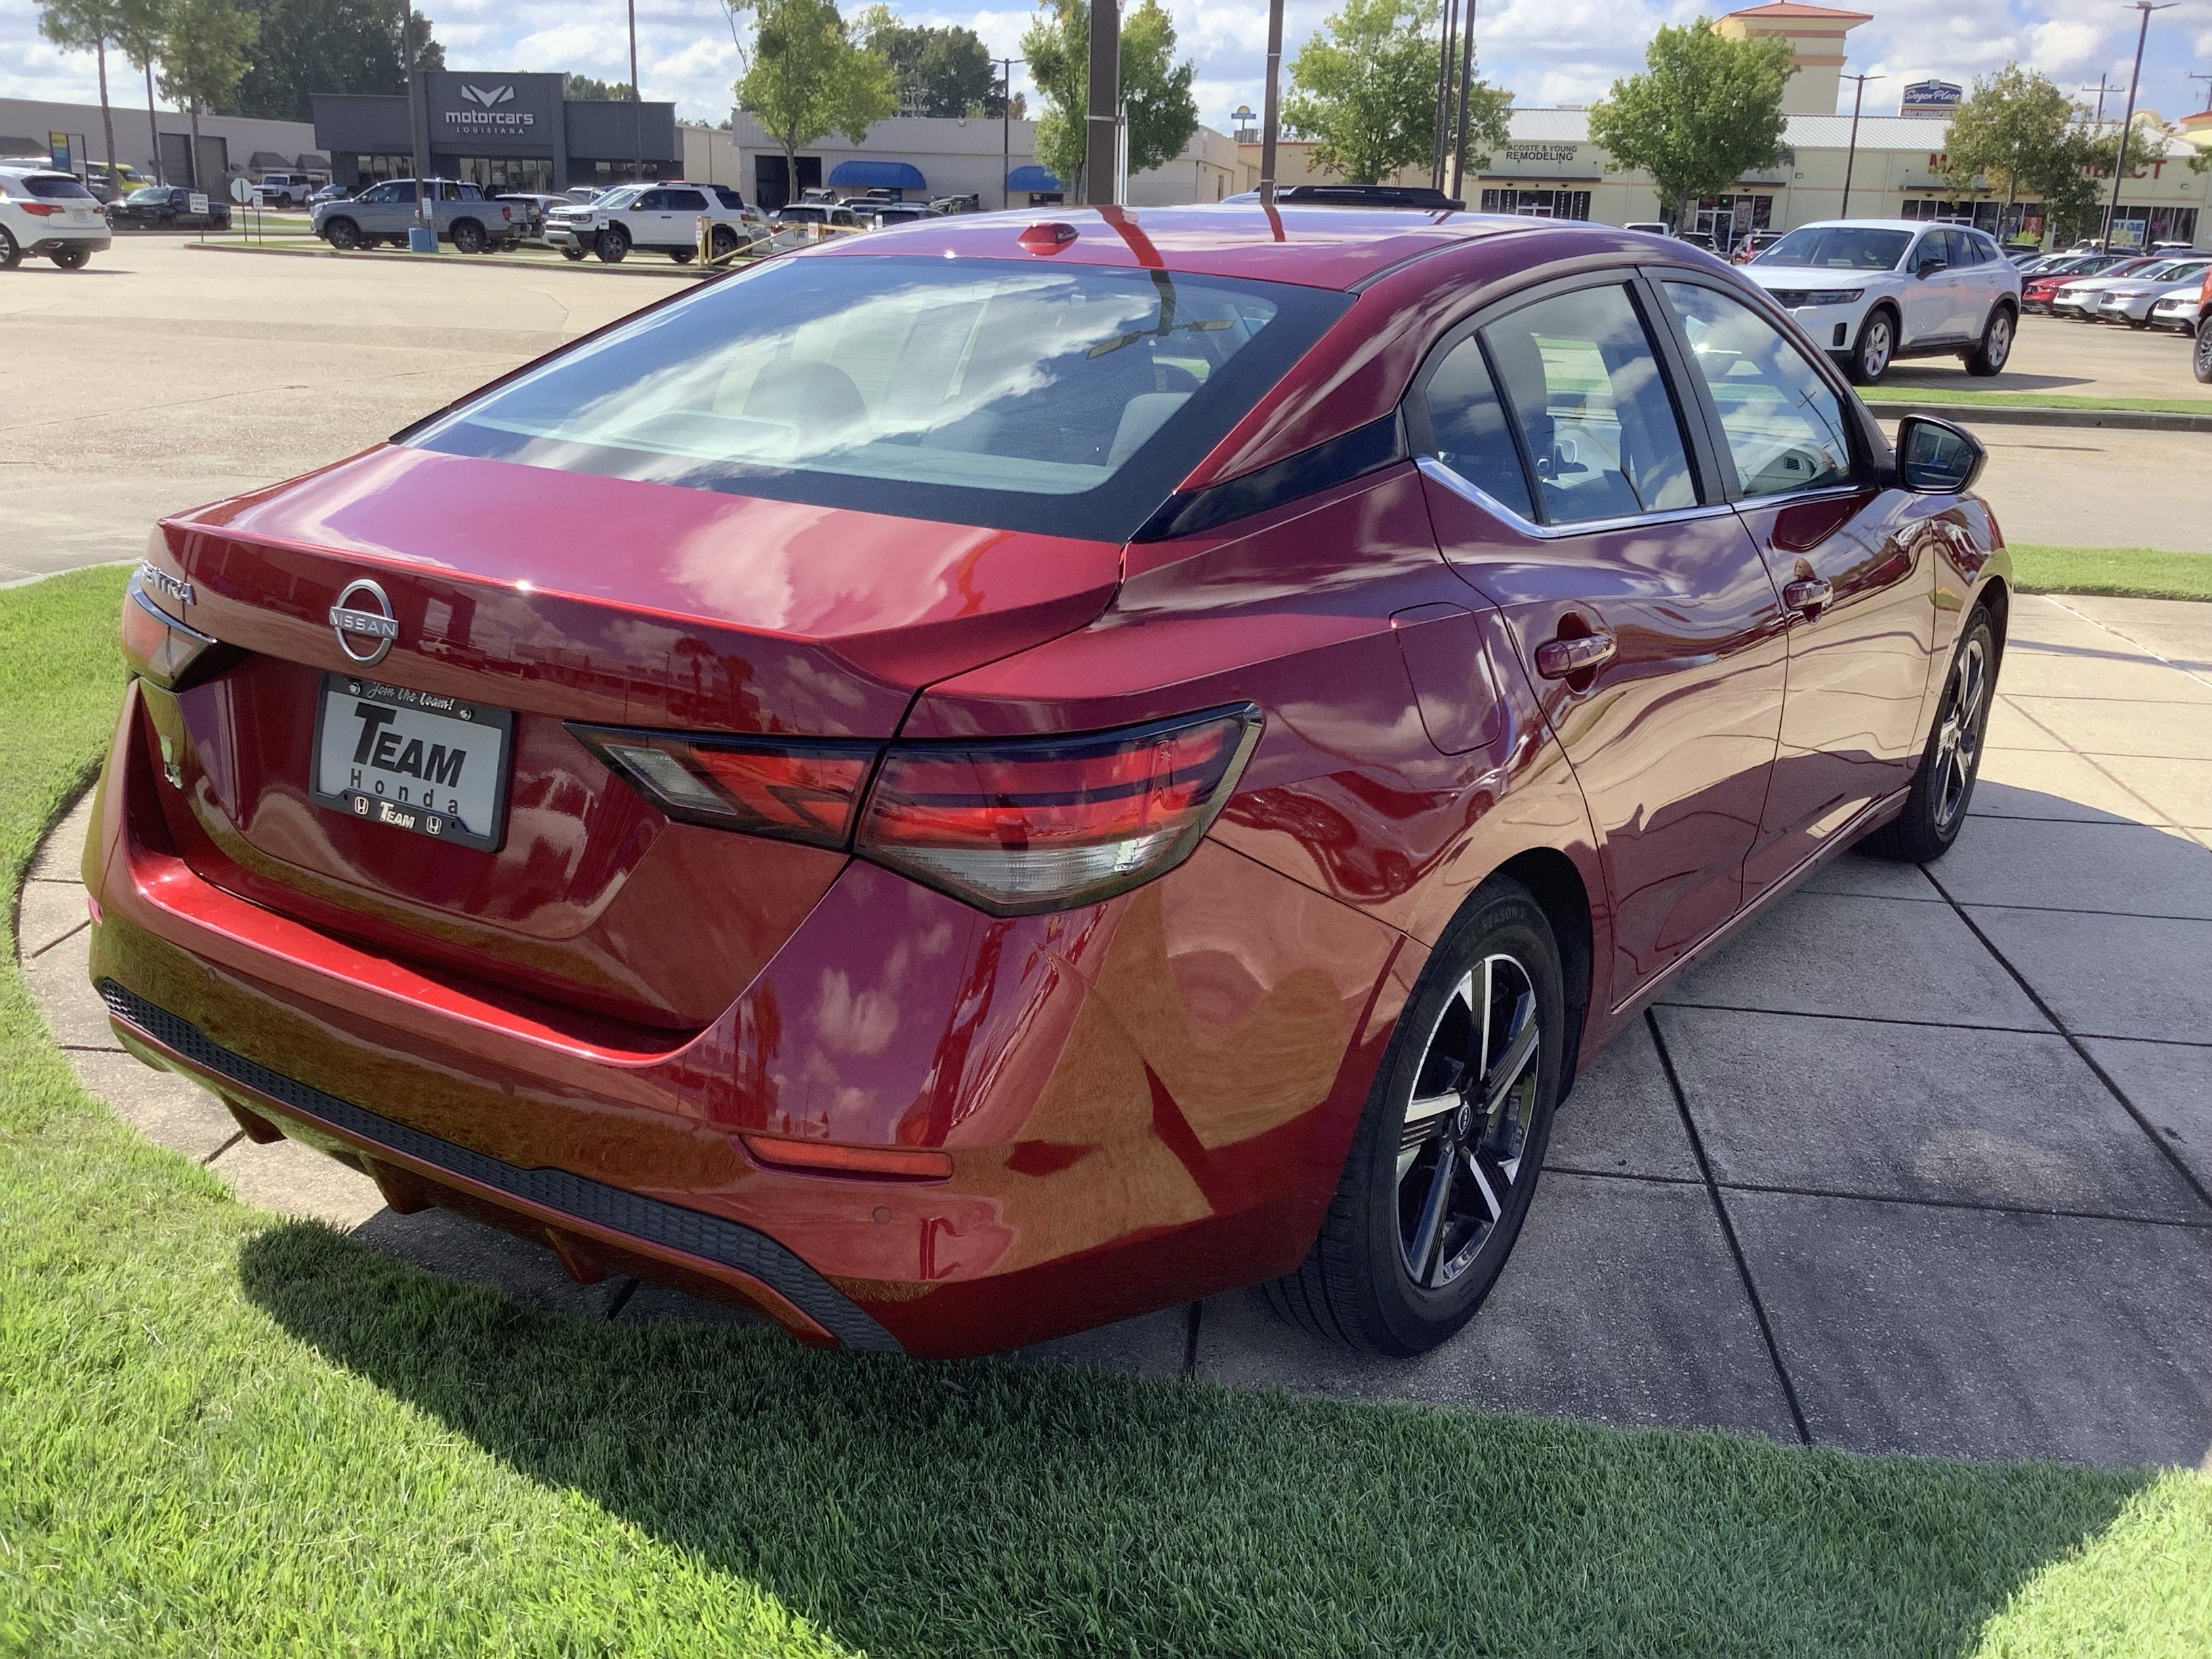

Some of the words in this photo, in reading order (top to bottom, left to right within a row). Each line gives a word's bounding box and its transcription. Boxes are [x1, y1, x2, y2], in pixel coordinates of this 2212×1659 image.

[445, 109, 534, 125] motorcars
[456, 126, 525, 134] LOUISIANA
[1504, 144, 1540, 152] LACOSTE
[1505, 151, 1574, 161] REMODELING
[331, 611, 396, 636] NISSAN
[367, 682, 396, 699] Join
[398, 688, 418, 702] the
[419, 693, 455, 710] team!
[352, 701, 467, 788] TEAM
[350, 768, 458, 815] Honda
[380, 801, 415, 830] TEAM
